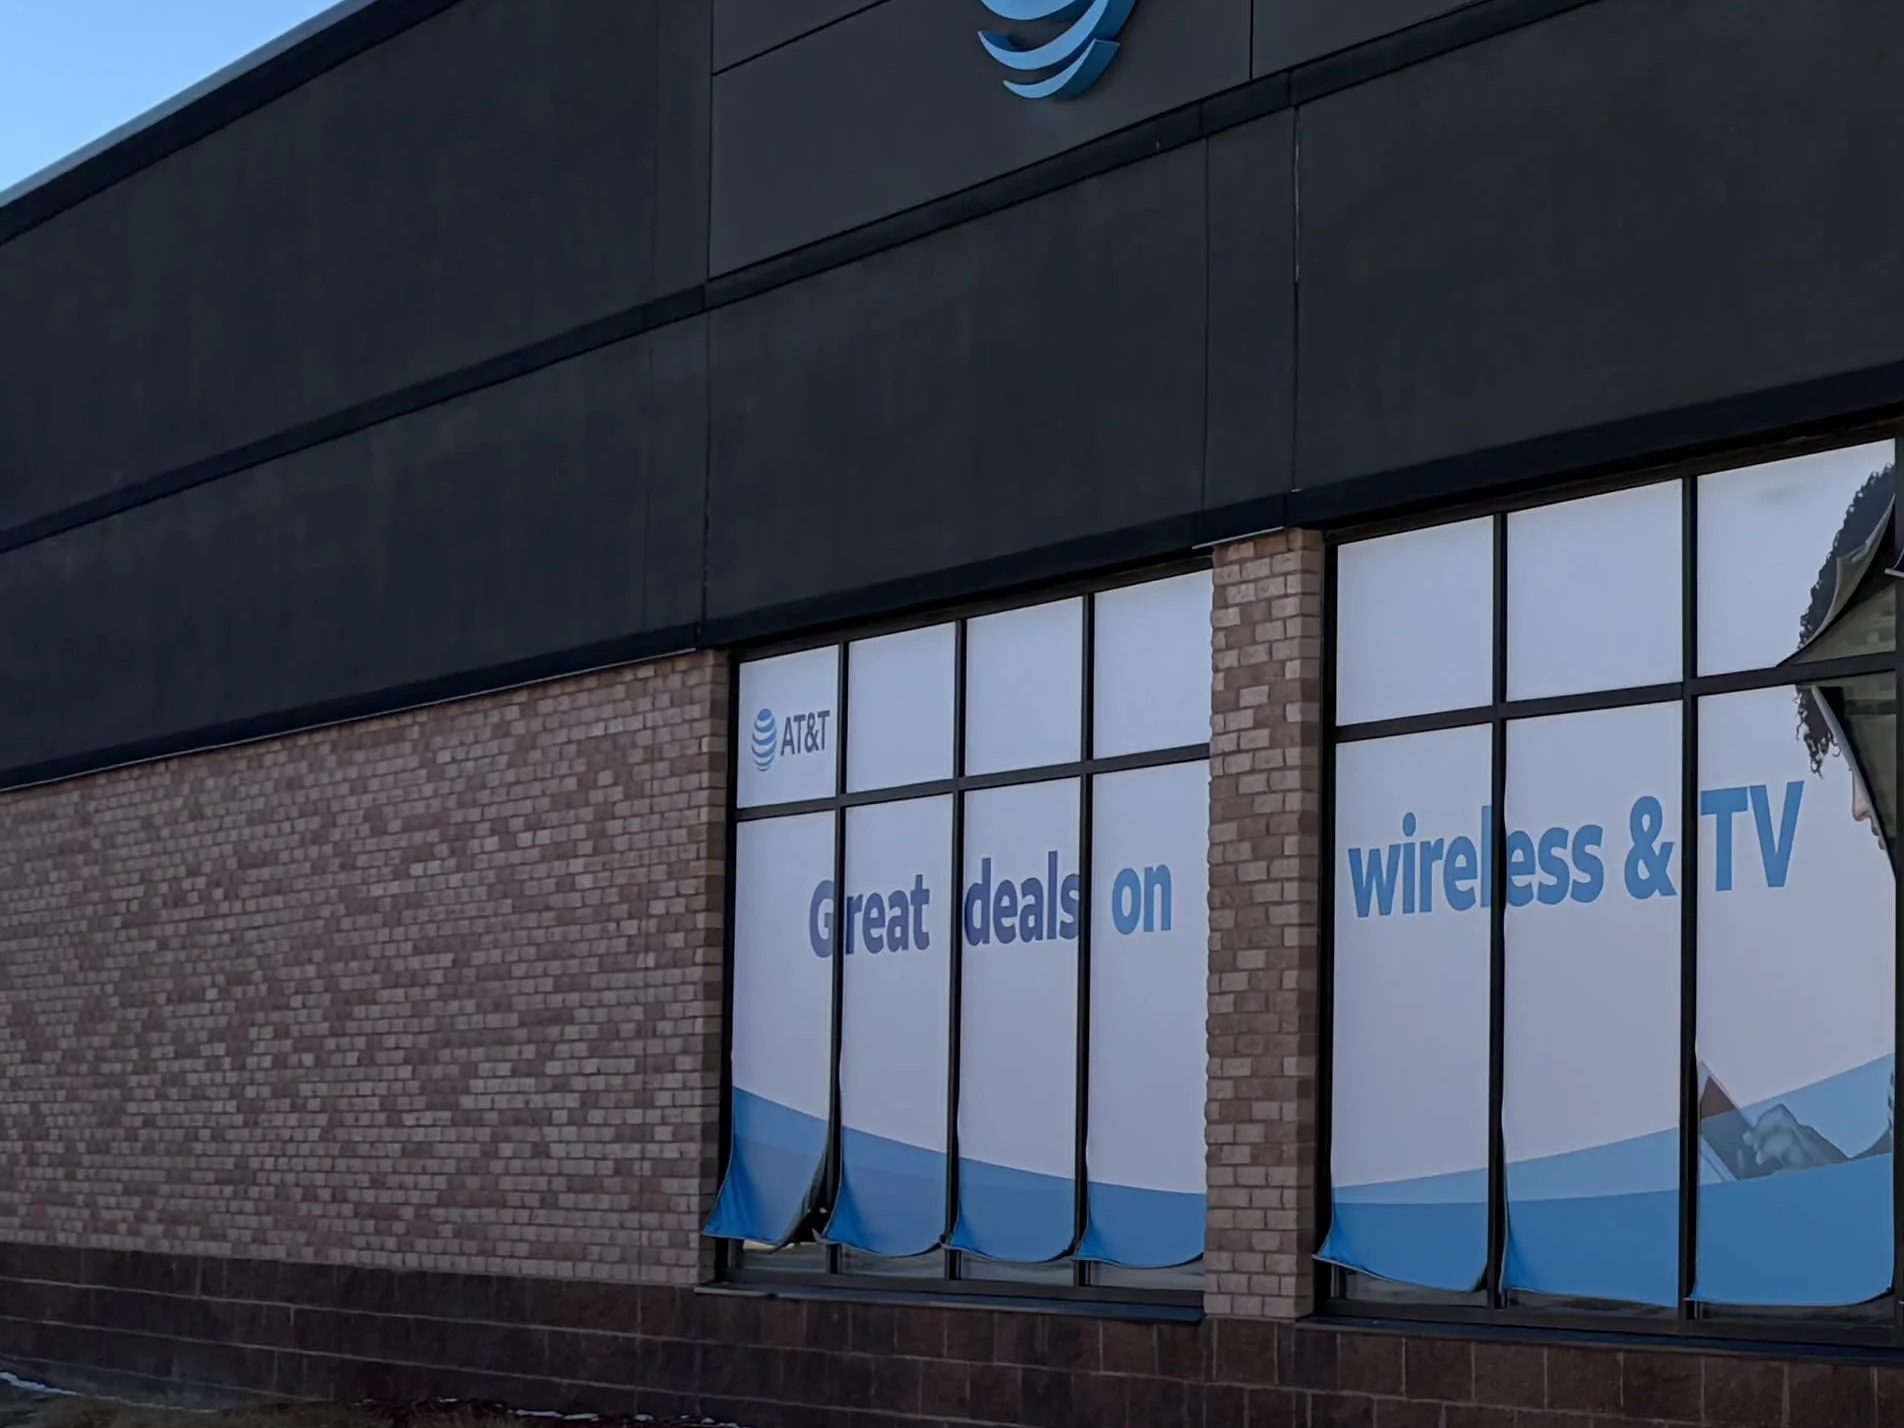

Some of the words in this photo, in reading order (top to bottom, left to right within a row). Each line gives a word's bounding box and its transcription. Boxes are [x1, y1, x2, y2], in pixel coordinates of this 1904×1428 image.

[780, 709, 831, 757] AT&T
[1348, 805, 1605, 918] wireless
[1624, 795, 1678, 901] &
[1701, 780, 1806, 891] TV
[809, 874, 931, 959] Great
[963, 850, 1080, 947] deals
[1111, 863, 1173, 936] on
